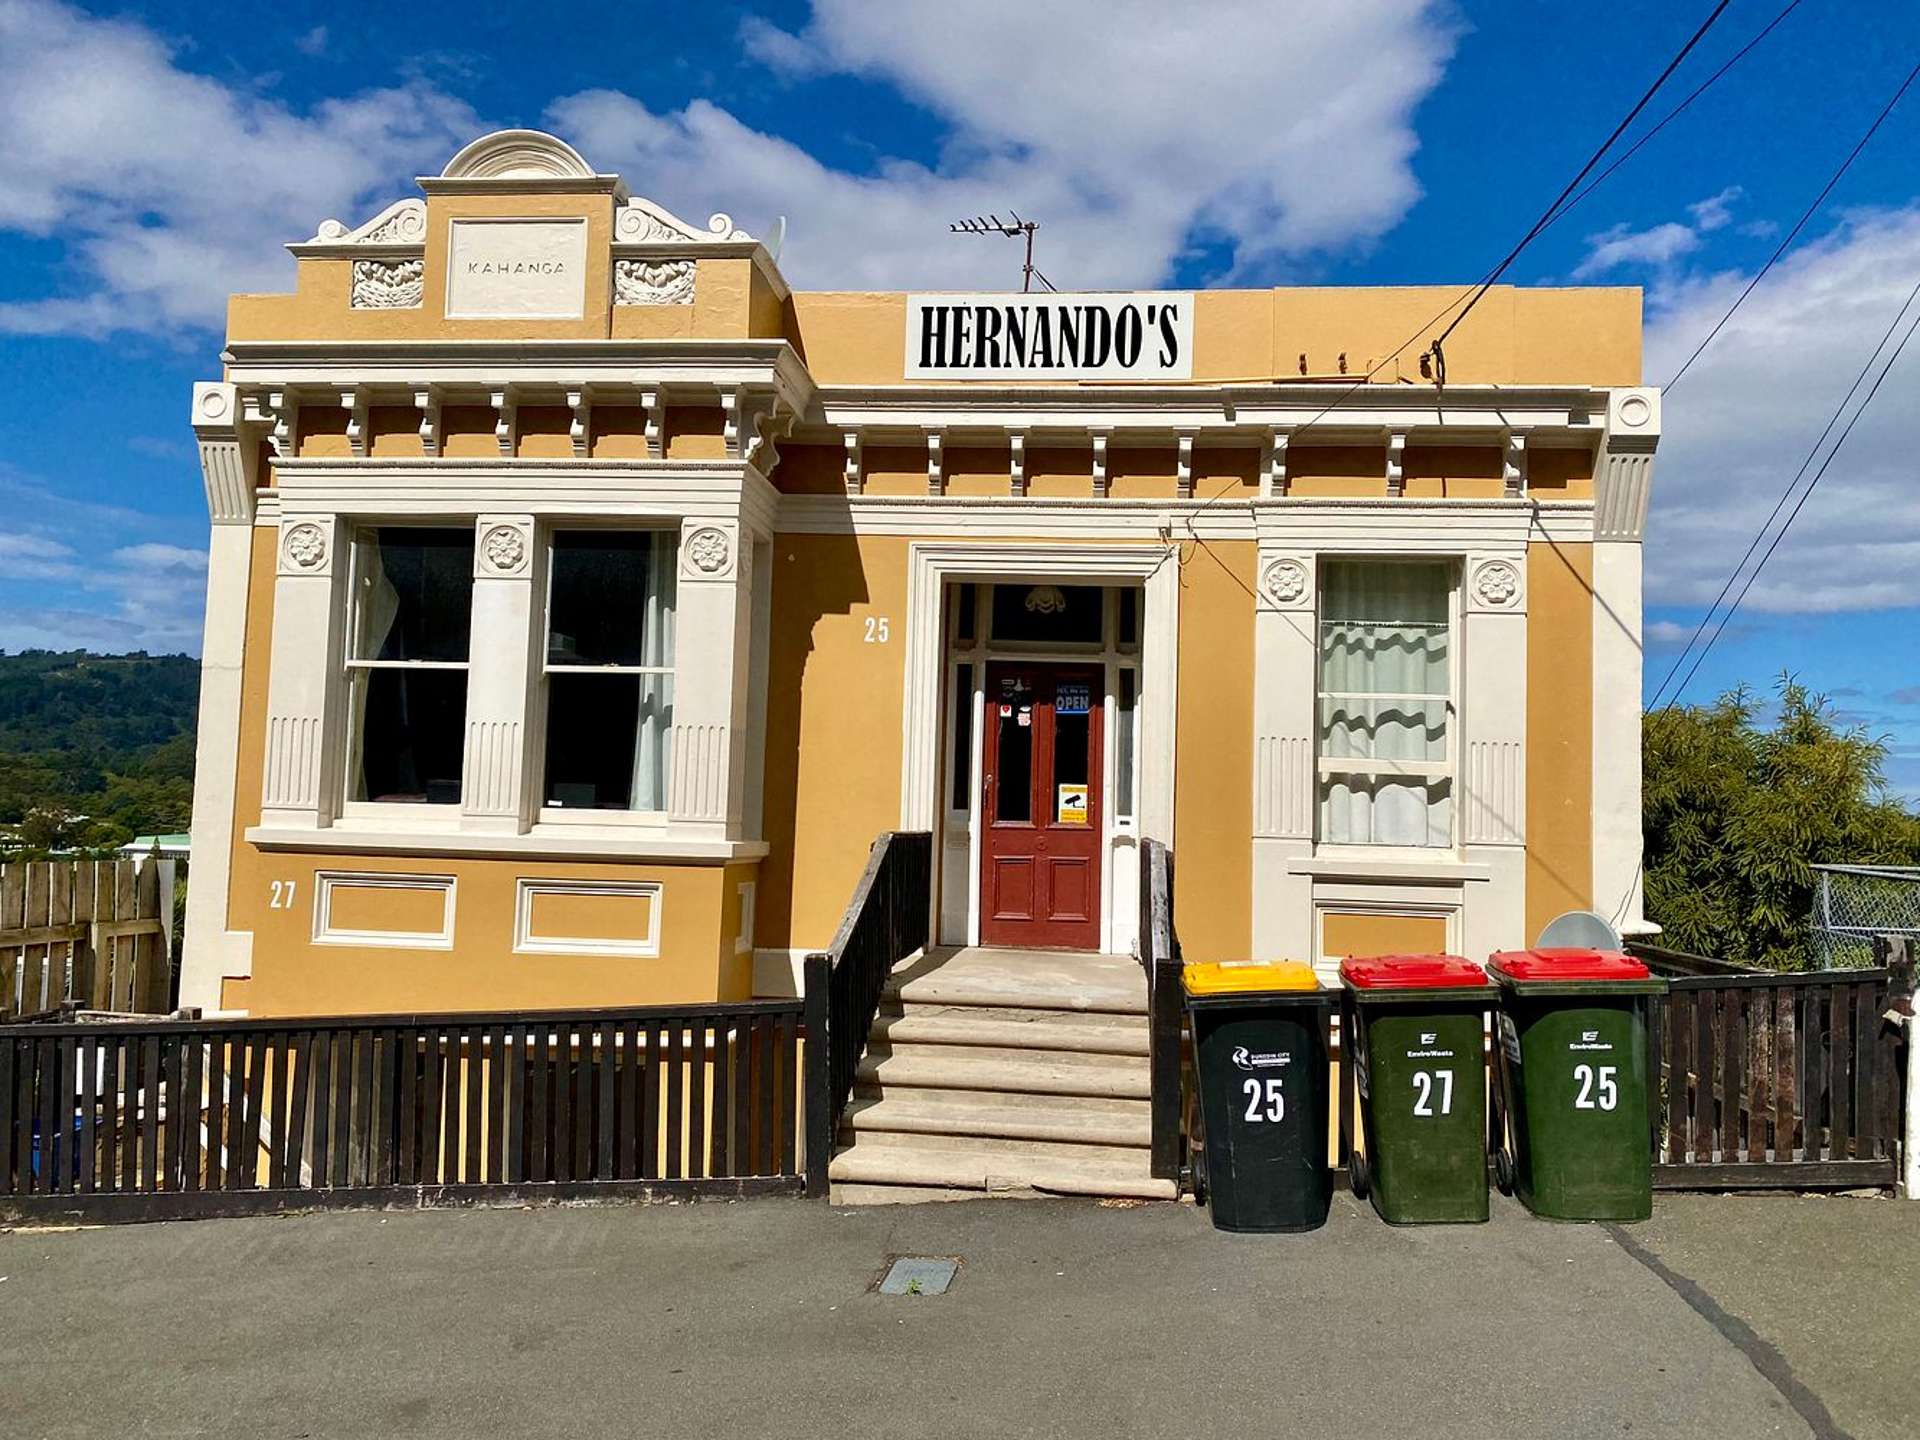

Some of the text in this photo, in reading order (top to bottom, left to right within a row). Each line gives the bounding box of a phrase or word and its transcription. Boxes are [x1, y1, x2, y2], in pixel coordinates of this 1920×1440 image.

[467, 262, 566, 274] KAHANGA
[918, 304, 1179, 369] HERNANDO'S
[864, 617, 889, 643] 25
[1056, 696, 1089, 710] OPEN
[270, 880, 296, 909] 27
[1243, 1079, 1284, 1122] 25
[1412, 1070, 1453, 1116] 27
[1574, 1064, 1618, 1111] 25
